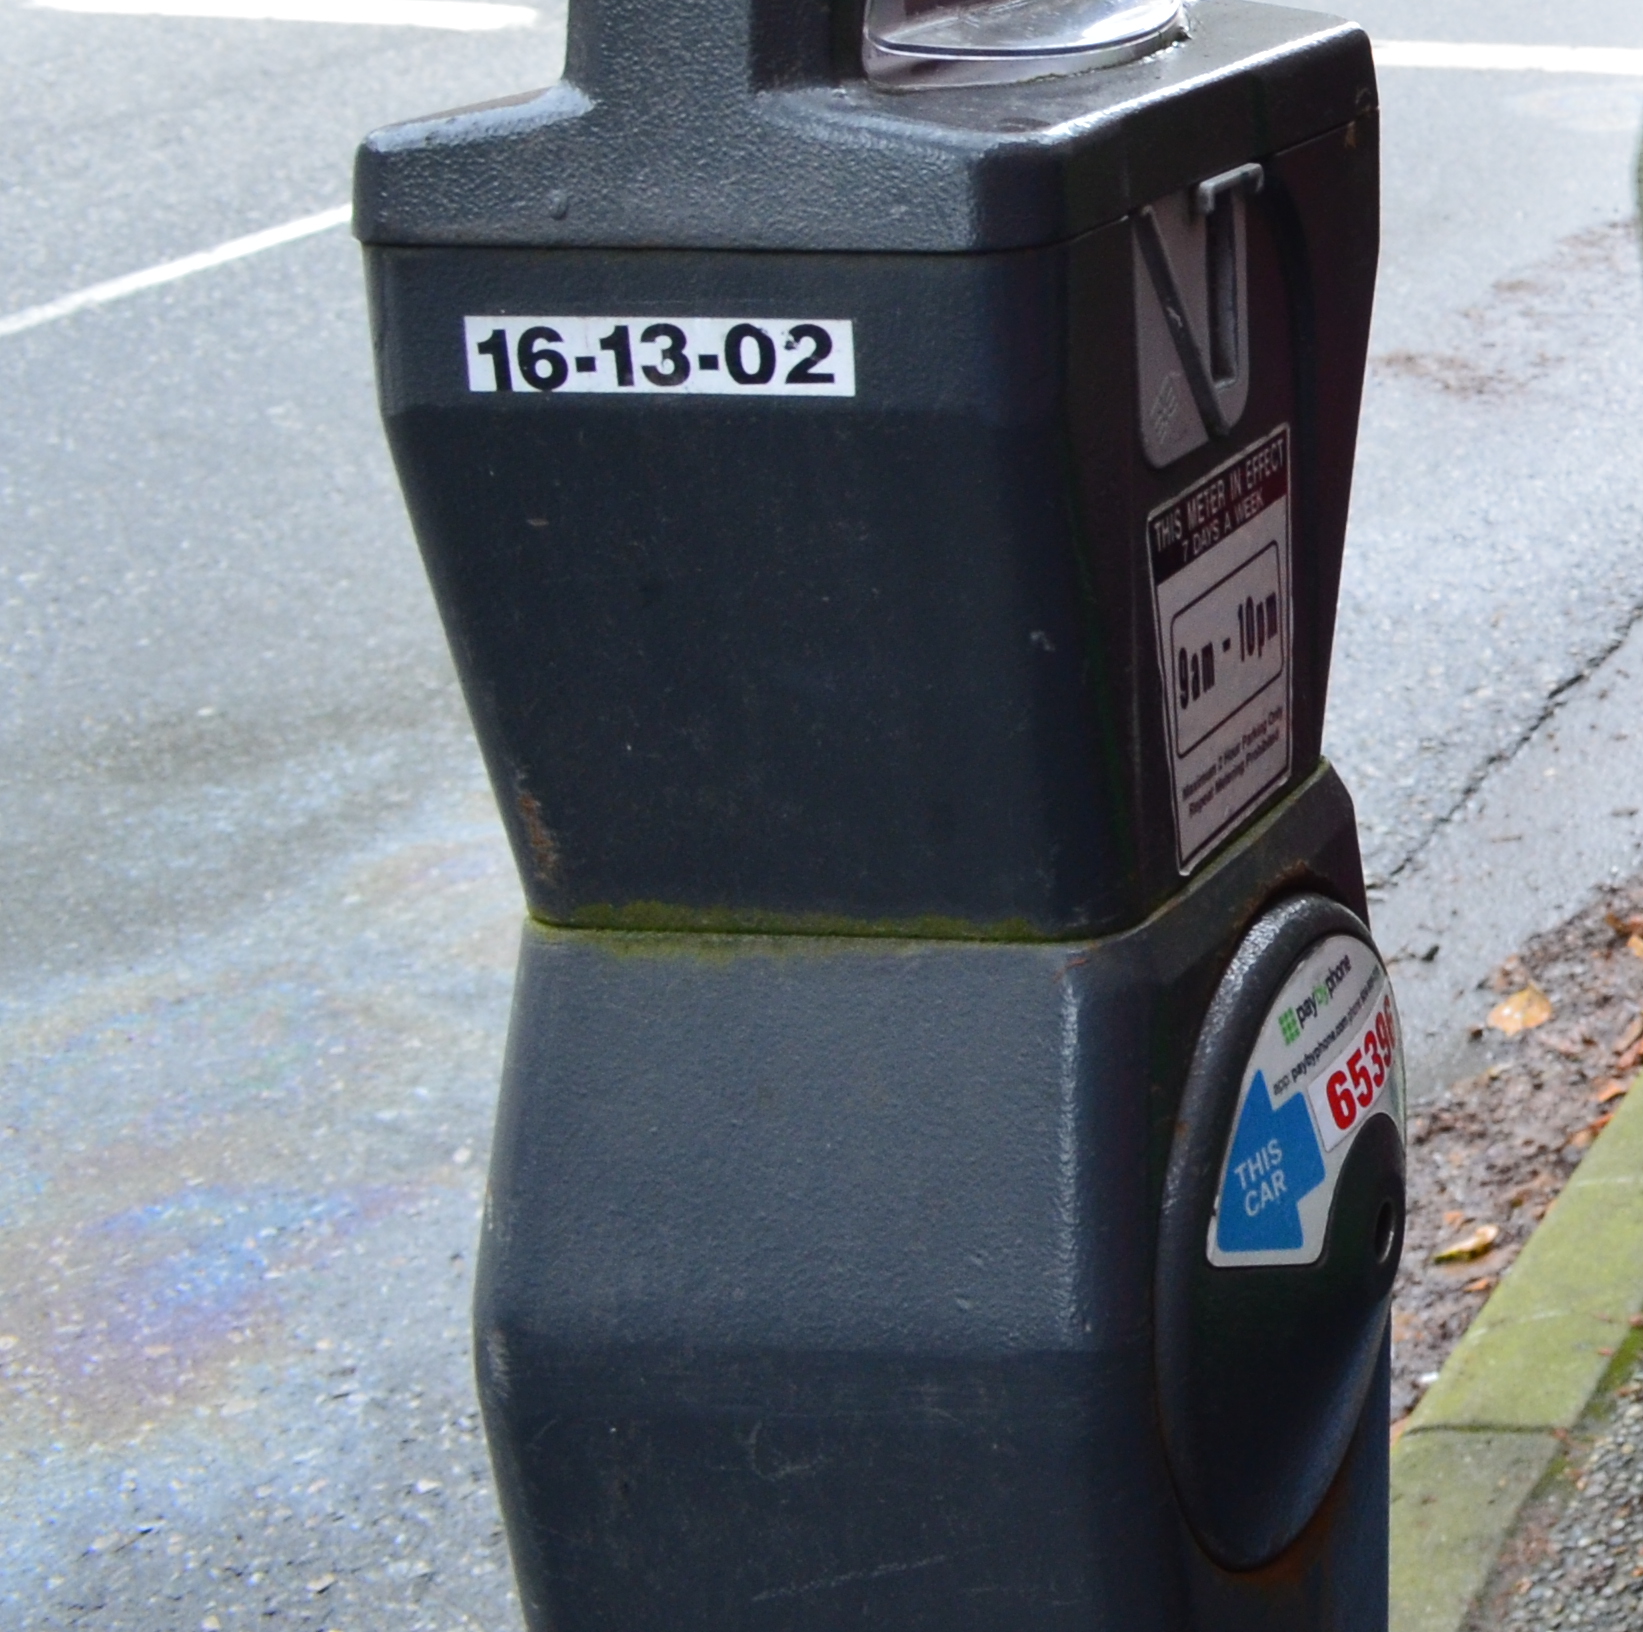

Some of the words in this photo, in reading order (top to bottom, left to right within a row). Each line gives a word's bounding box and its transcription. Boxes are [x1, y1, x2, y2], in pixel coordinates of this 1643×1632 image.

[477, 322, 835, 391] 16-13-02
[1154, 508, 1182, 552] THIS
[1187, 479, 1225, 531] METER
[1229, 467, 1241, 500] IN
[1245, 438, 1284, 489] EFFECT
[1182, 539, 1188, 562] 7
[1193, 519, 1220, 555] DAYS
[1224, 511, 1232, 534] A
[1234, 487, 1264, 524] WEEK
[1178, 639, 1215, 710] 9am
[1237, 591, 1278, 663] 10pm
[1296, 954, 1352, 1029] paybyphone
[1326, 994, 1395, 1130] 65396
[1234, 1138, 1282, 1190] THIS
[1245, 1169, 1287, 1216] CAR
